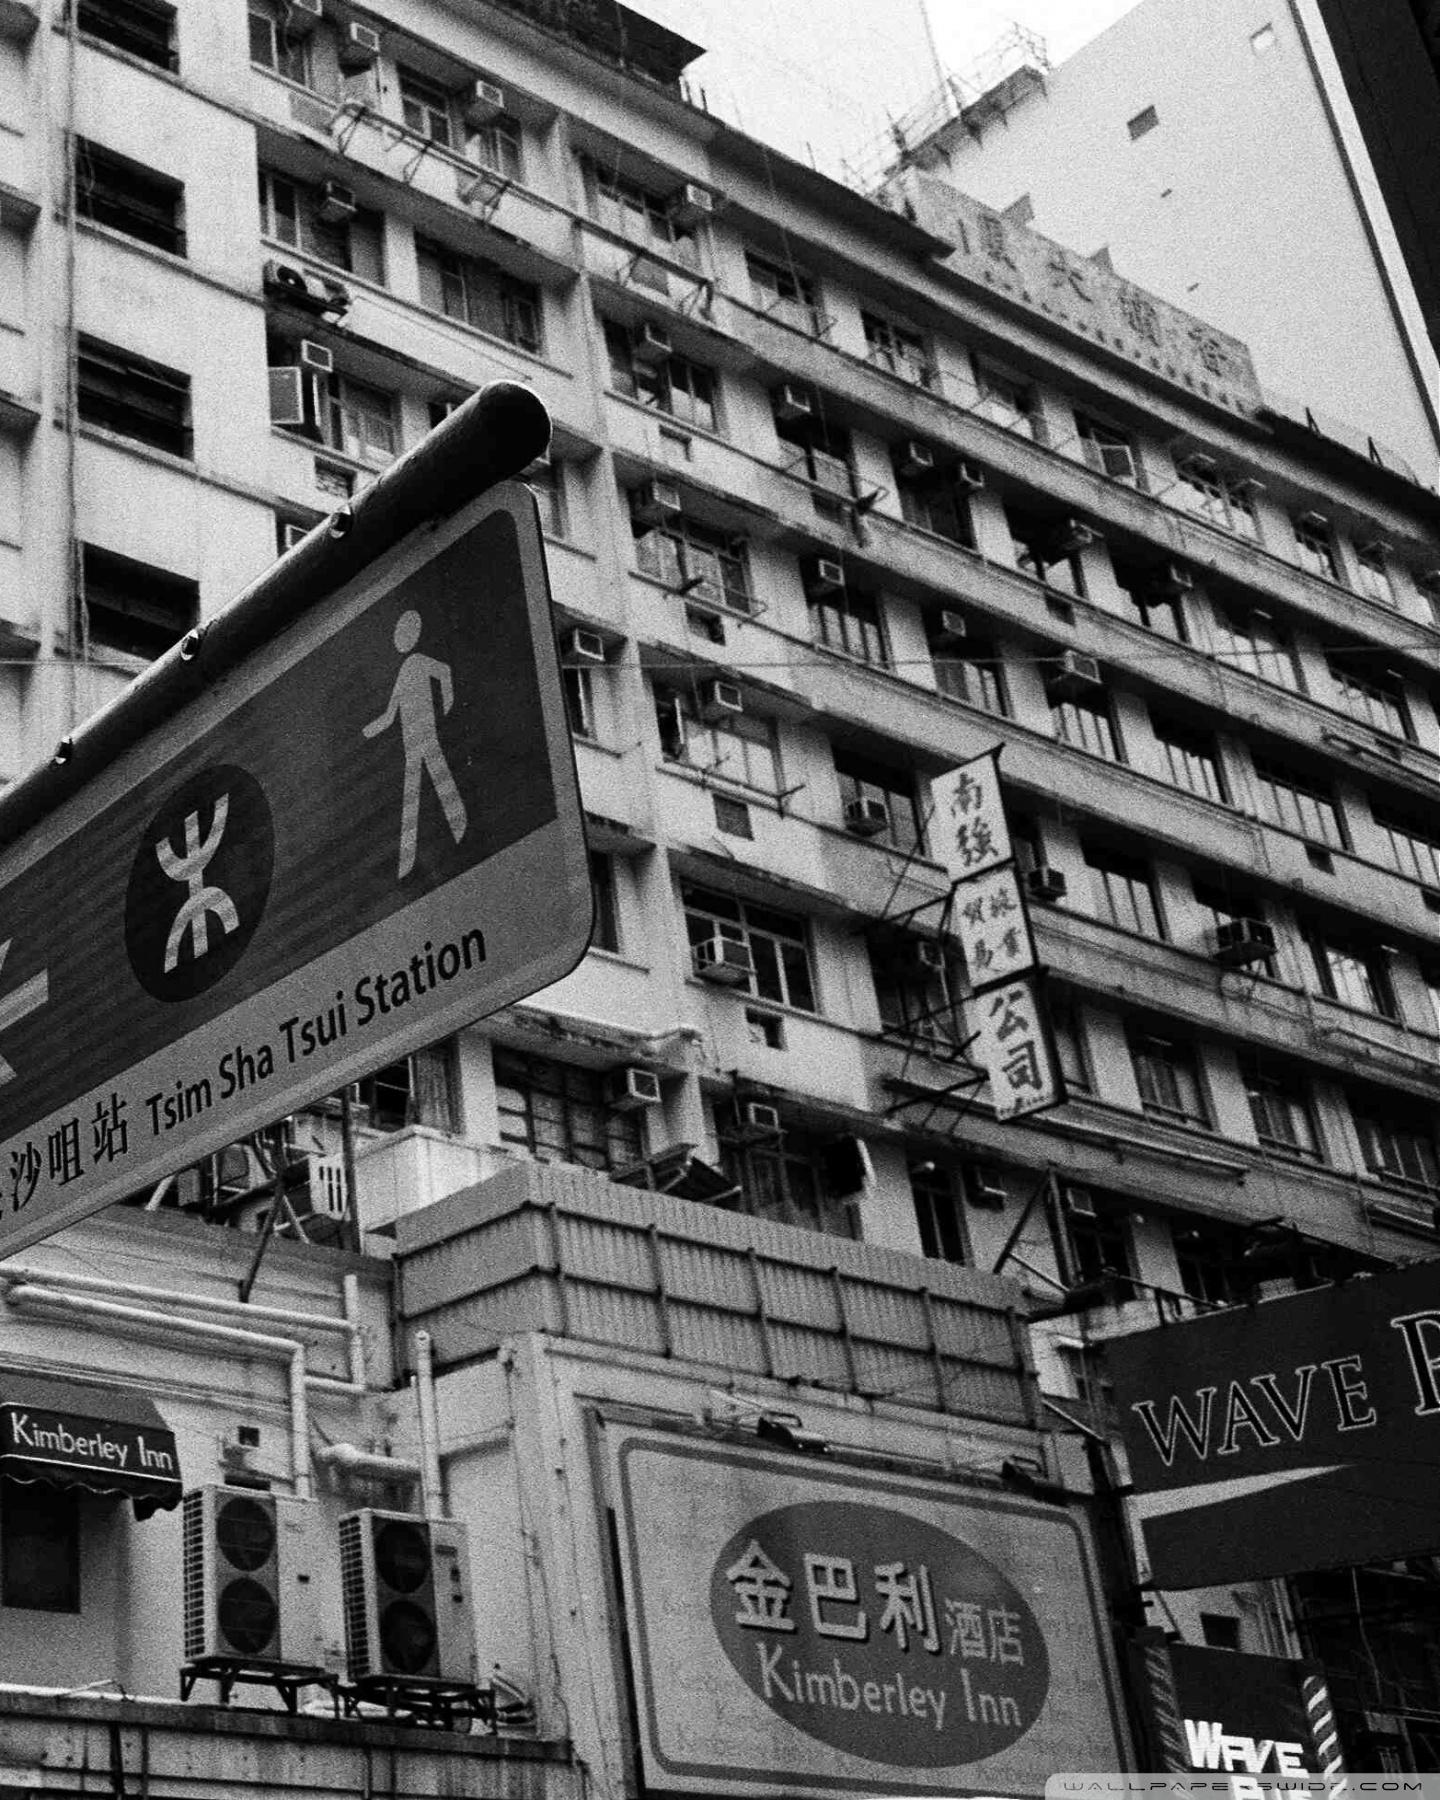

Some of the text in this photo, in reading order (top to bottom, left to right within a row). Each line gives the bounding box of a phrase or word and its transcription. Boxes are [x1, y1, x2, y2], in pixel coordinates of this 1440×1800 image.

[146, 1076, 213, 1138] Tsim
[219, 1046, 275, 1101] Sha
[278, 991, 349, 1066] Tsui
[357, 928, 488, 1026] Station
[989, 990, 1042, 1090] 公司
[10, 1412, 173, 1470] Kimberley Inn
[1131, 1354, 1377, 1468] WAVE
[756, 1642, 1023, 1731] Kimberley Inn
[1184, 1719, 1310, 1779] WAVE
